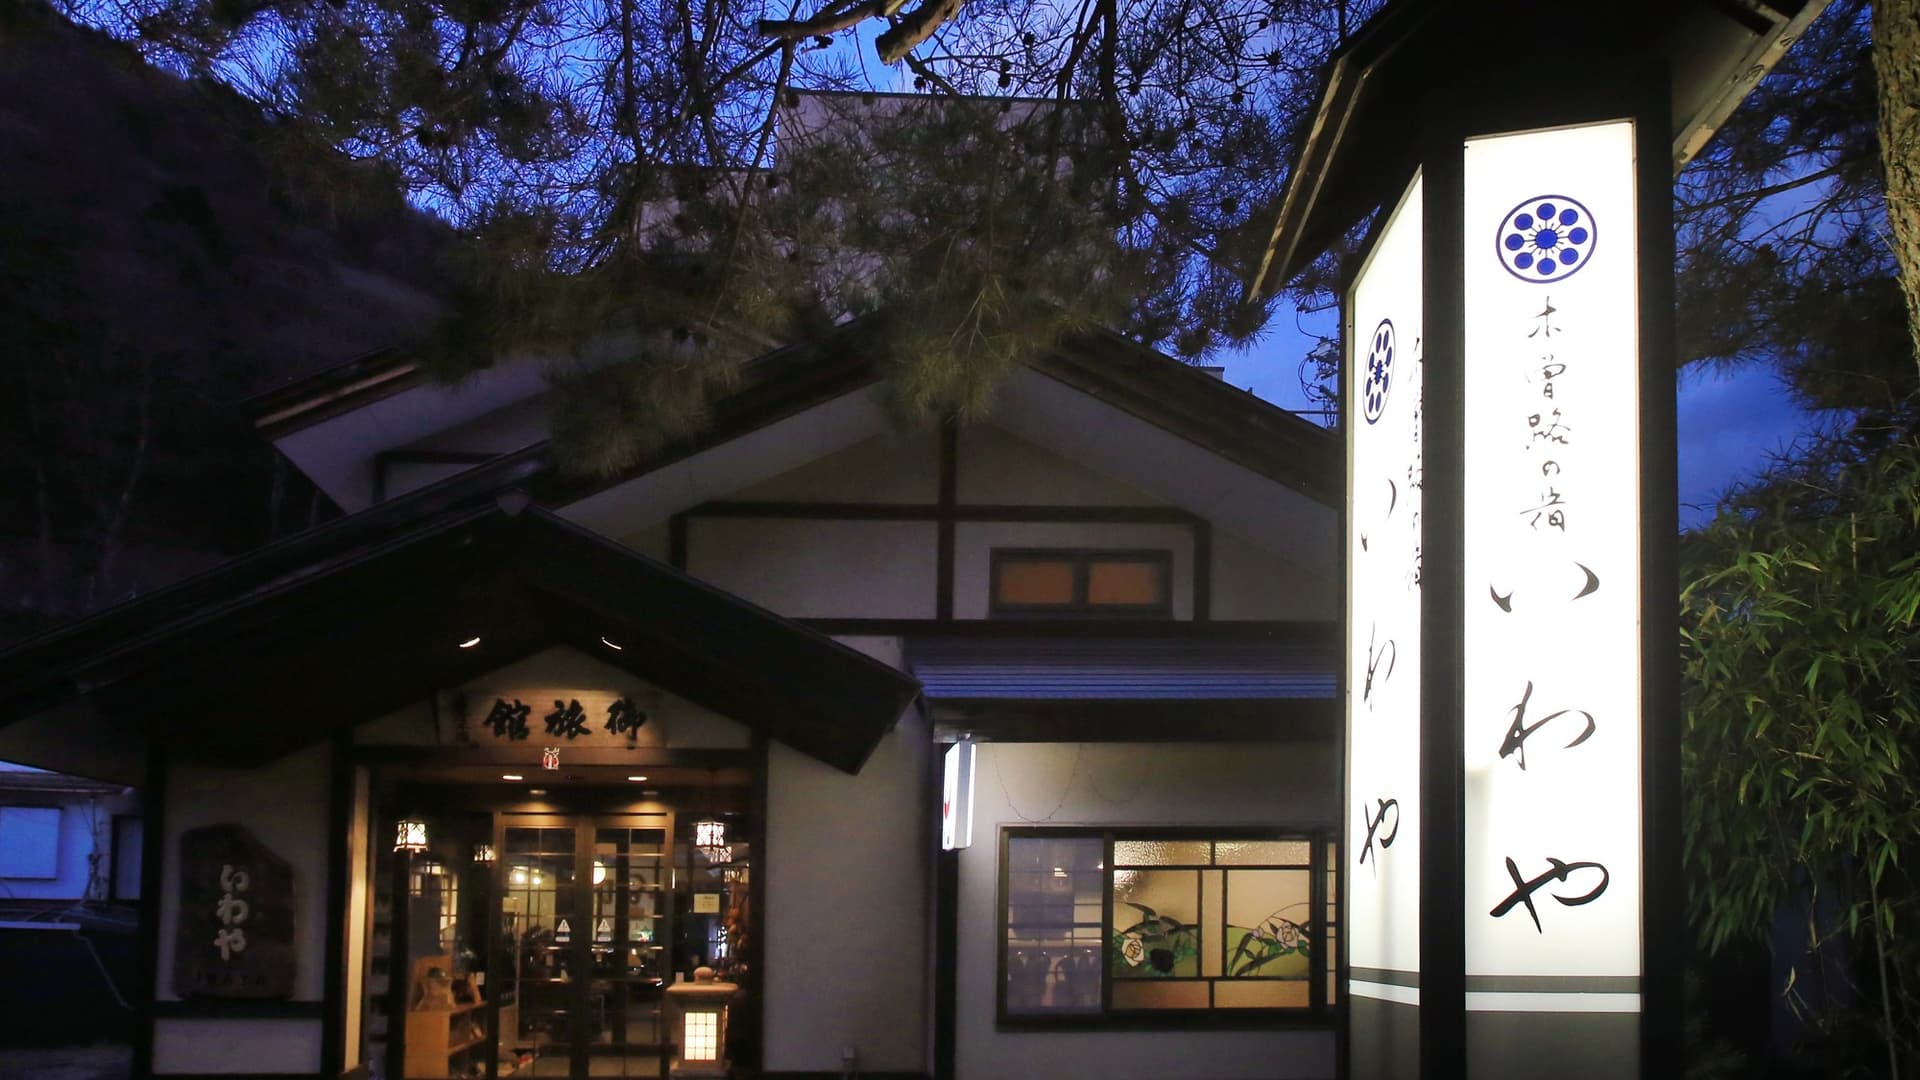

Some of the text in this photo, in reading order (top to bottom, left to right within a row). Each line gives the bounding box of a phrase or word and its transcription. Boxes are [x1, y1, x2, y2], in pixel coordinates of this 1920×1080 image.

[1359, 478, 1400, 877] いわや
[1490, 563, 1611, 934] いわや
[213, 863, 250, 961] いわや
